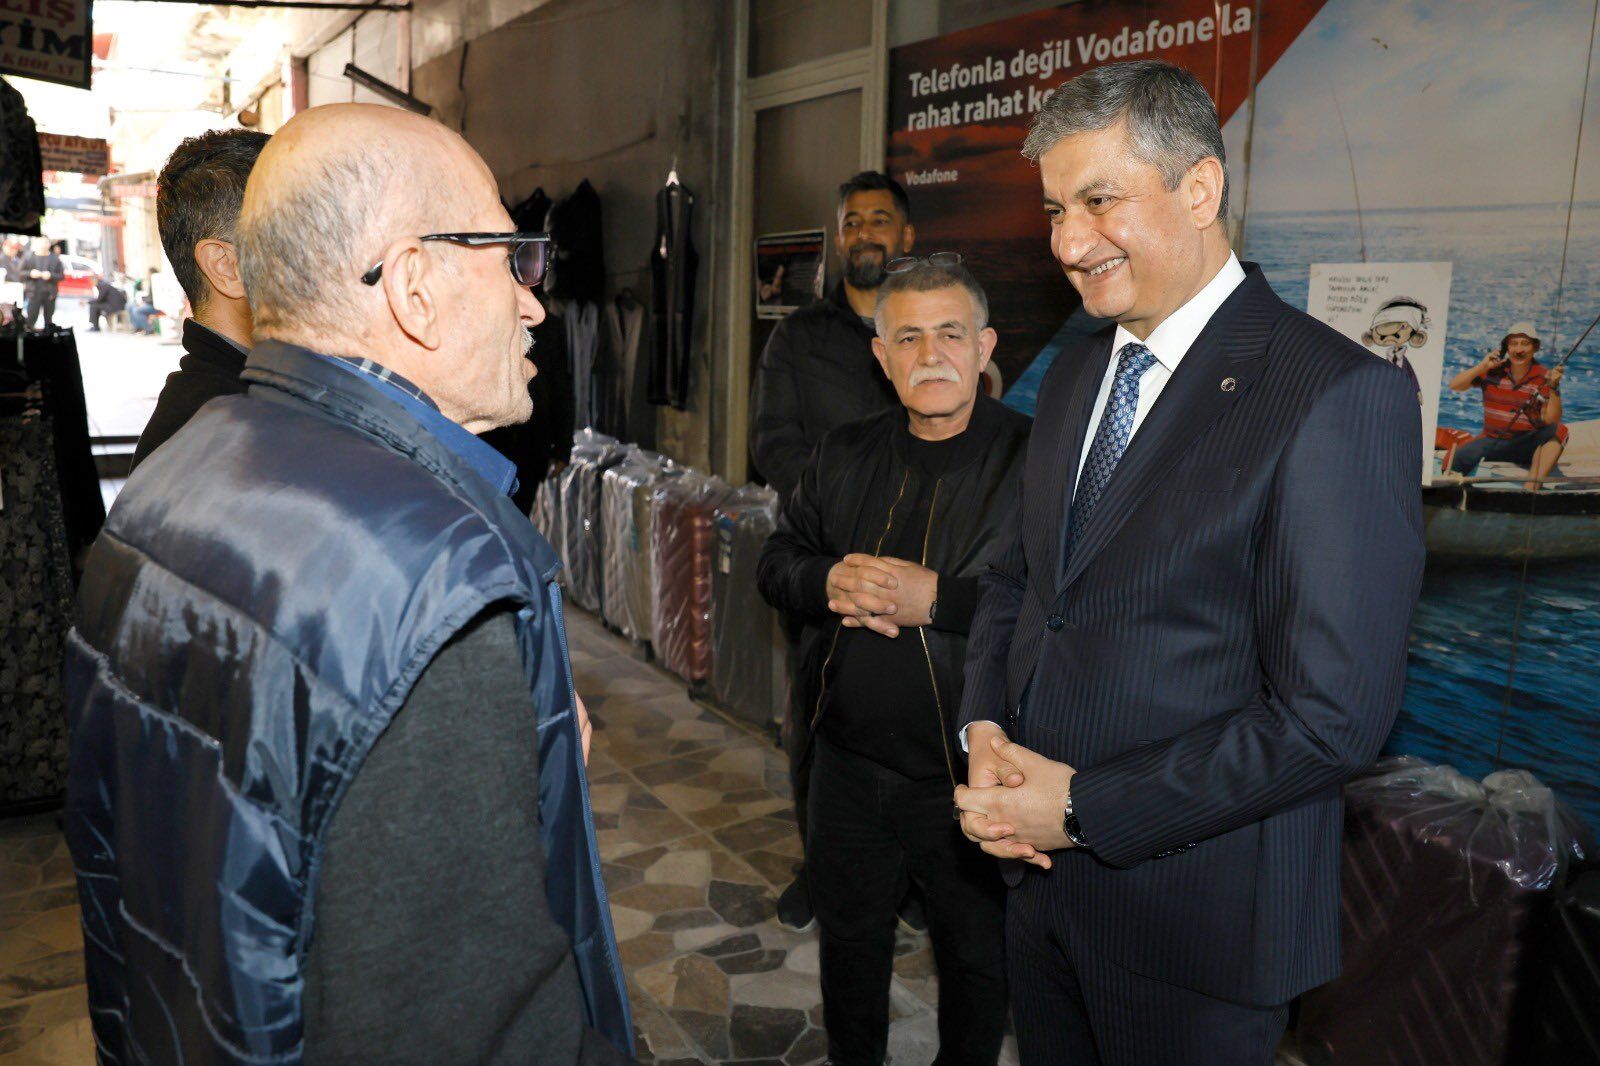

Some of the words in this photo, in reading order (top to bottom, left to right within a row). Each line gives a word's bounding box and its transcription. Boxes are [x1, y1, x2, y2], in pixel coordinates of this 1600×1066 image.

[908, 56, 1006, 97] Telefonla
[1010, 39, 1072, 80] değil
[907, 103, 961, 132] rahat
[964, 92, 1023, 123] rahat
[905, 168, 958, 186] Vodafone
